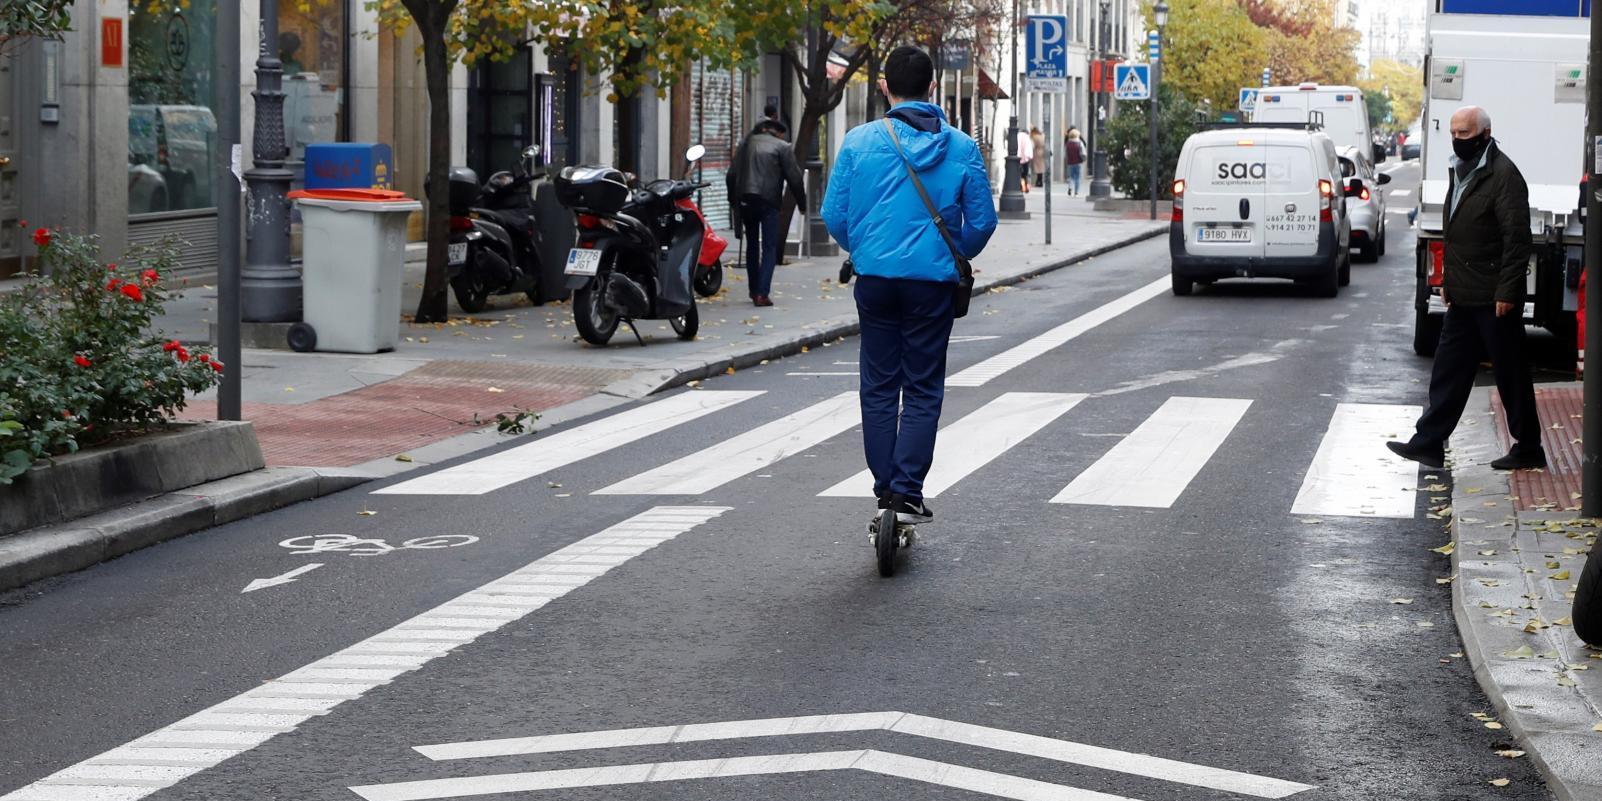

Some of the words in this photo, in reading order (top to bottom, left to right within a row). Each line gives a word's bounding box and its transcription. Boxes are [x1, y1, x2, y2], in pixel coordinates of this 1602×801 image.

[1029, 18, 1063, 62] P
[1205, 230, 1227, 239] 9180
[1231, 230, 1248, 239] HVX
